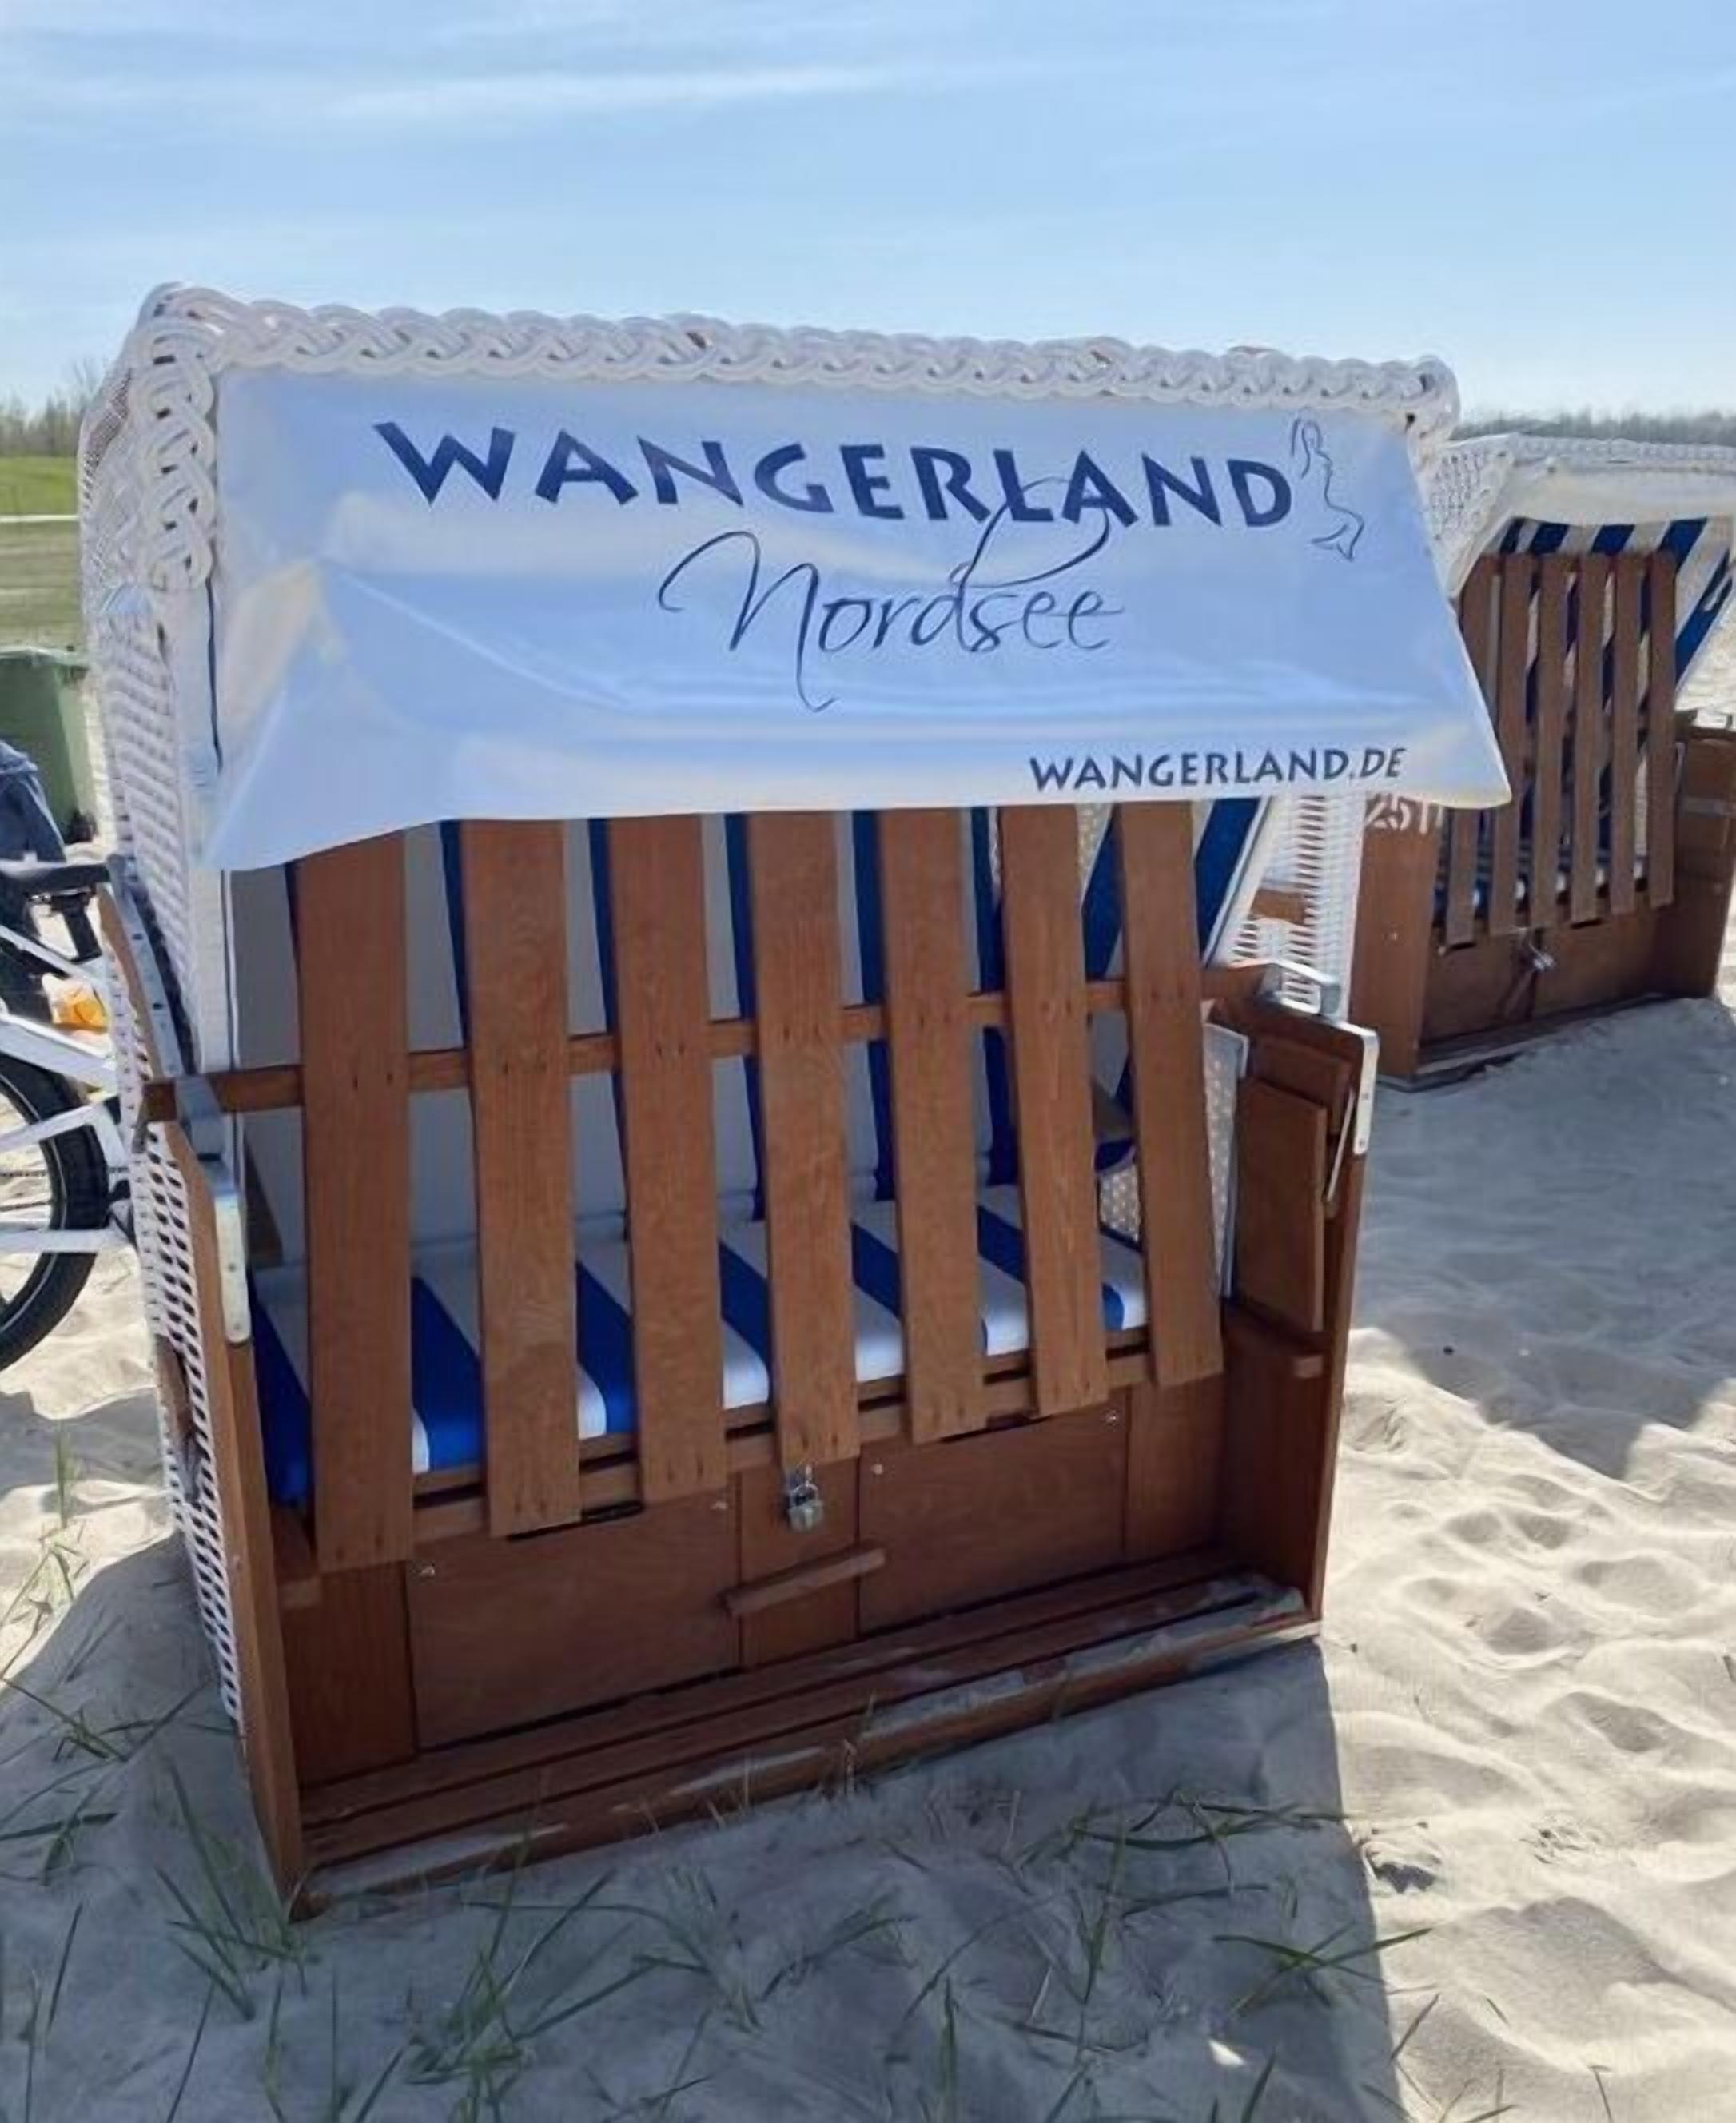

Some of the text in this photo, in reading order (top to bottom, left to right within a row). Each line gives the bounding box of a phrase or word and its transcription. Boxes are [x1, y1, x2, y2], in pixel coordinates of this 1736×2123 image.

[372, 420, 1292, 528] WANGERLAND
[659, 478, 1124, 712] Nordsee
[1029, 747, 1408, 792] WANGERLAND.DE
